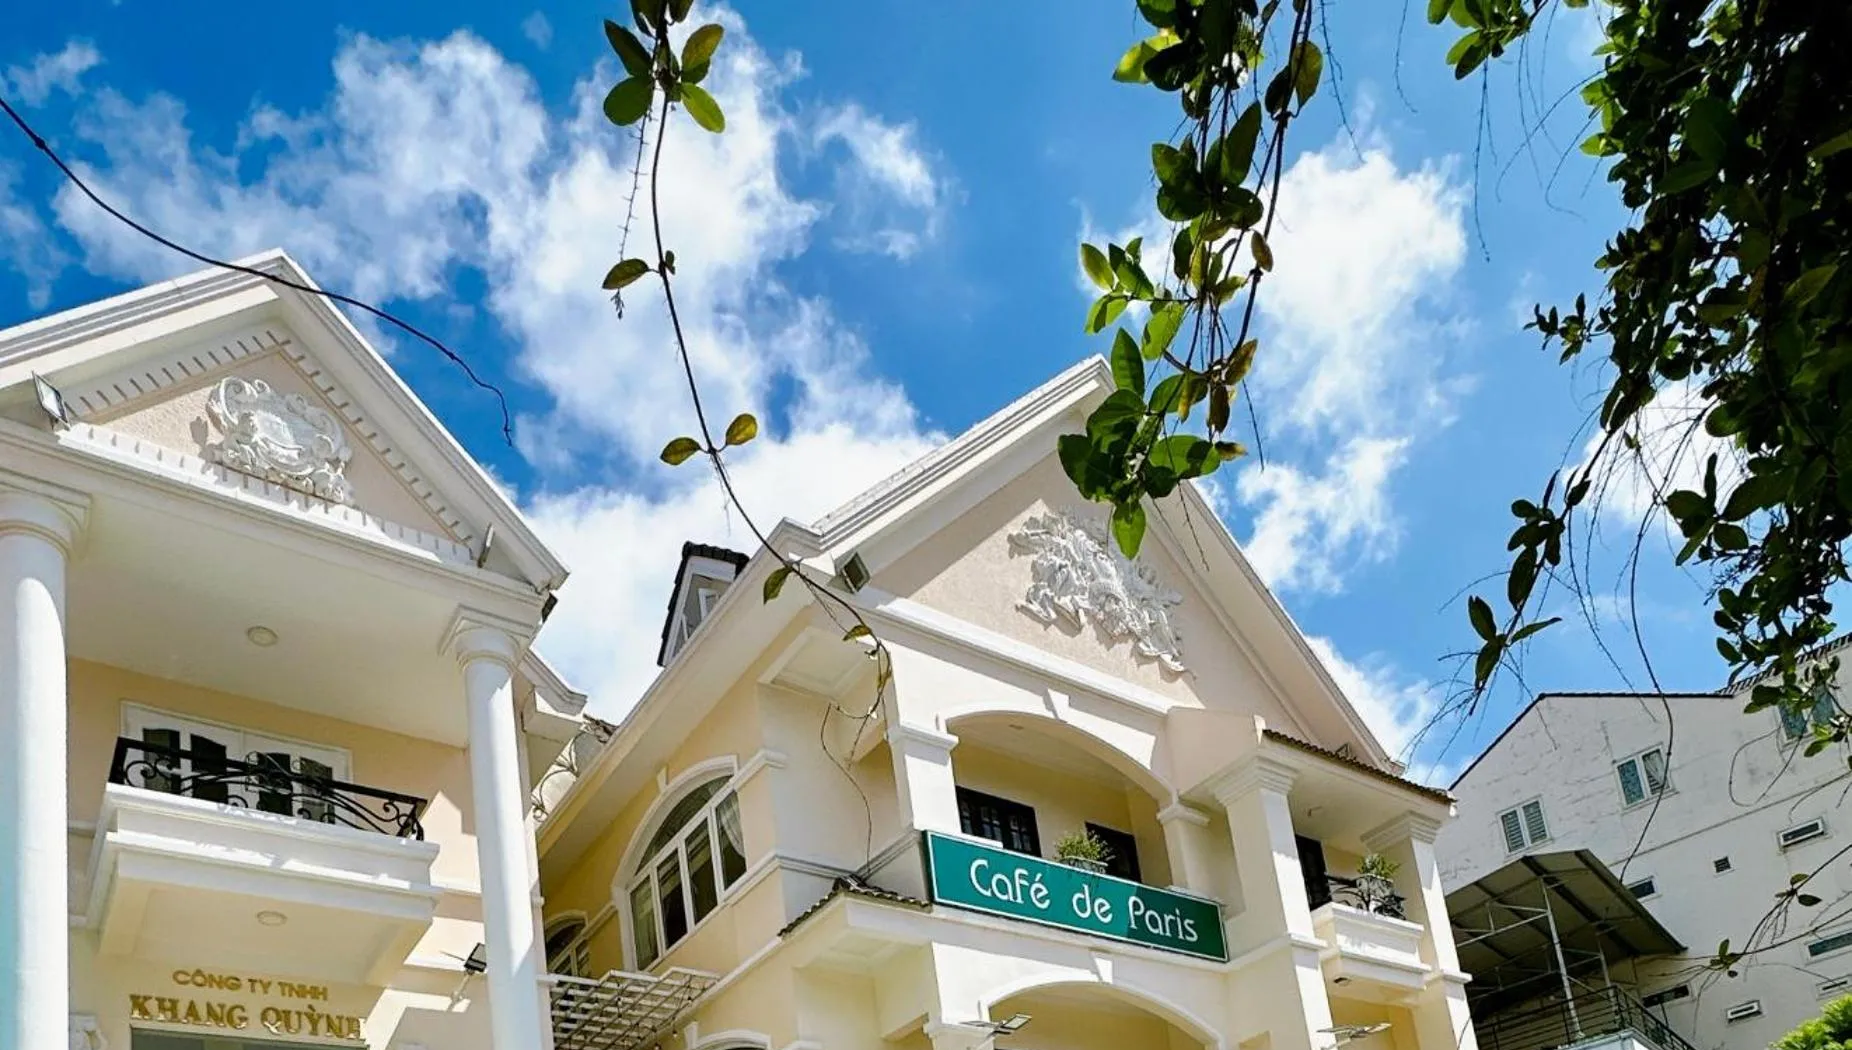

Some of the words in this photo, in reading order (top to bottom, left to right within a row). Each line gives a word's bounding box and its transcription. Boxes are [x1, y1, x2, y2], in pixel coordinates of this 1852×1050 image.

[970, 859, 1050, 909] Café
[1072, 884, 1112, 924] de
[1128, 896, 1198, 942] Paris
[172, 968, 242, 992] CÔNG
[247, 978, 272, 995] TY
[277, 981, 329, 1001] TNHH
[130, 994, 249, 1030] KHANG
[260, 1004, 368, 1040] QUỲNH
